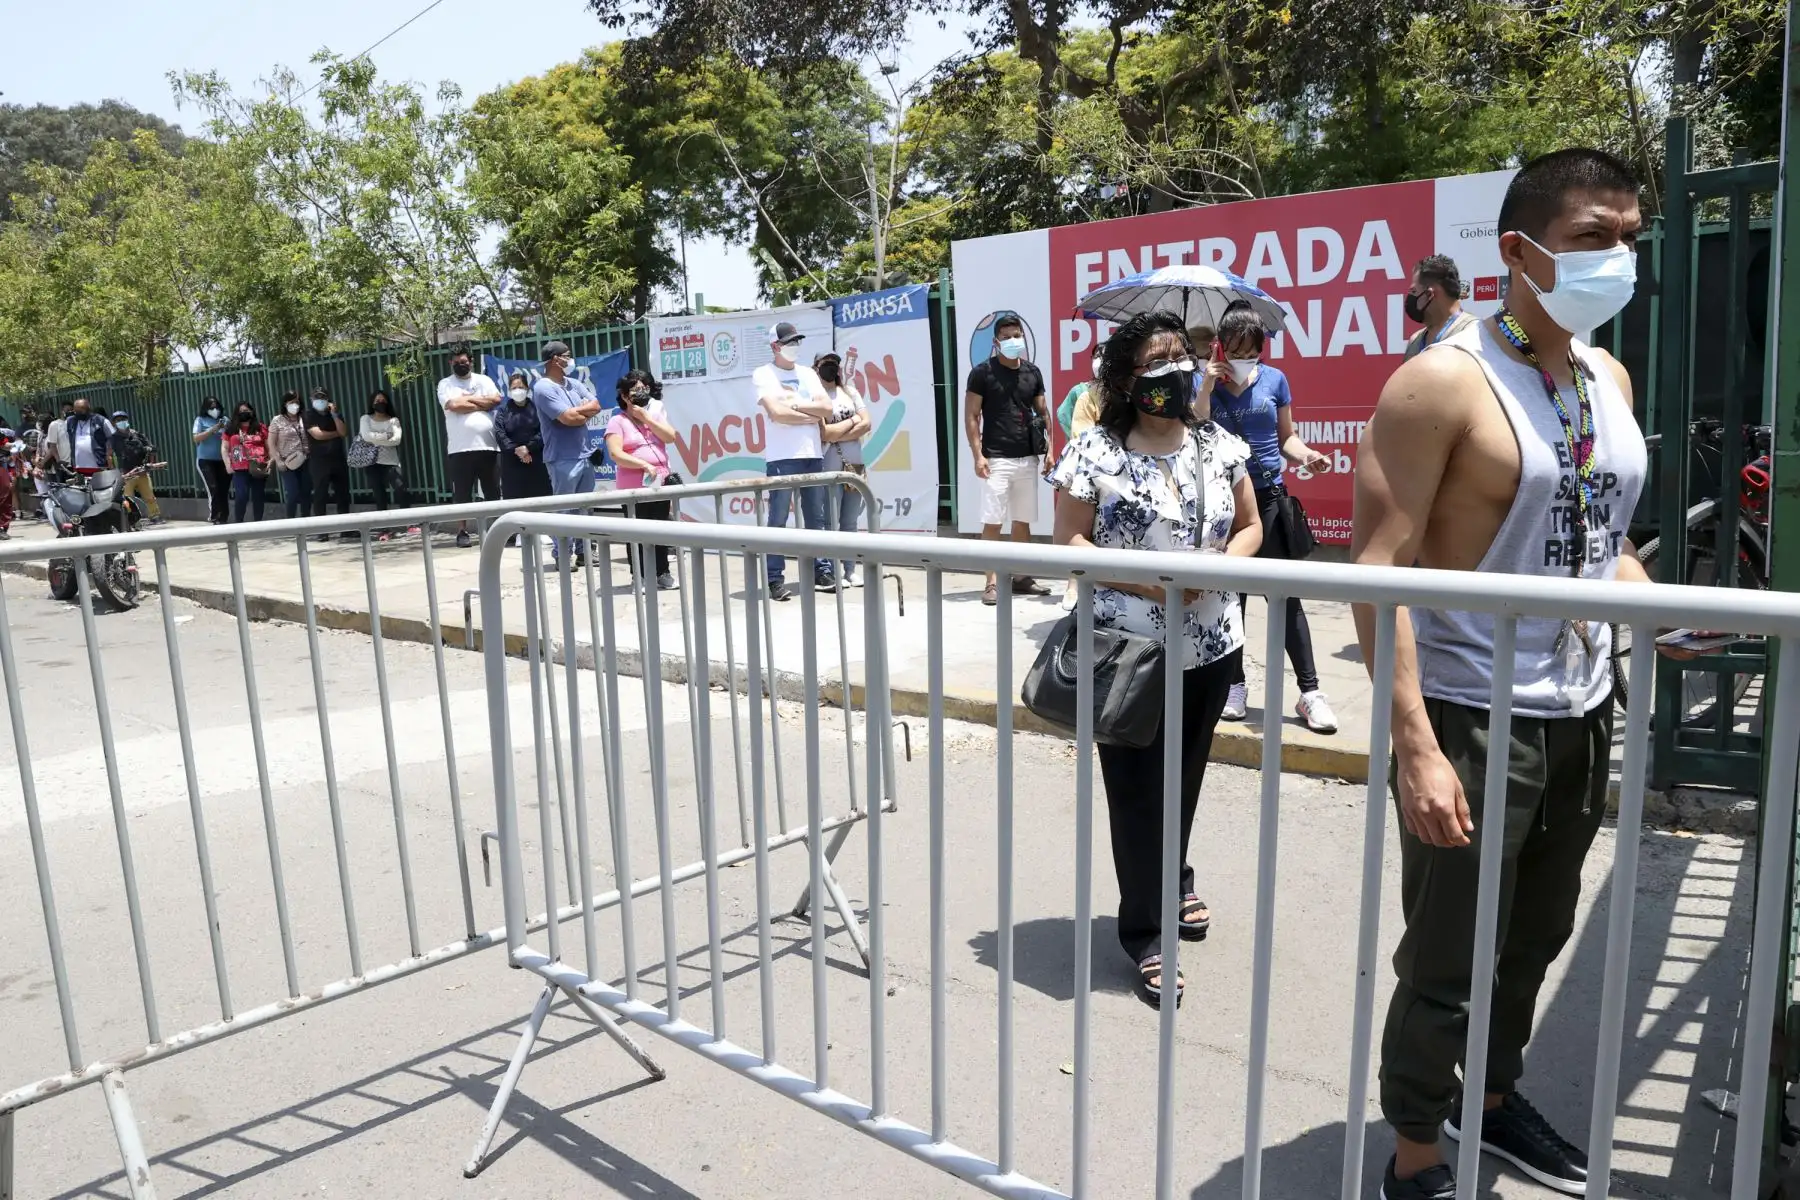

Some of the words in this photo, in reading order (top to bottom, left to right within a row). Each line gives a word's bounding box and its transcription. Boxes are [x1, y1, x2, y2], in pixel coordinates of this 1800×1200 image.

[1460, 227, 1498, 239] Gobier
[1075, 219, 1405, 306] ENTRADA
[1476, 283, 1496, 293] PERÚ
[842, 292, 913, 323] MINSA
[716, 339, 730, 352] 36
[664, 353, 678, 370] 27
[687, 351, 703, 368] 28
[1554, 471, 1622, 500] SLEP.
[1307, 518, 1319, 527] tu
[1551, 503, 1610, 533] TRIN
[1543, 531, 1622, 567] REEAT
